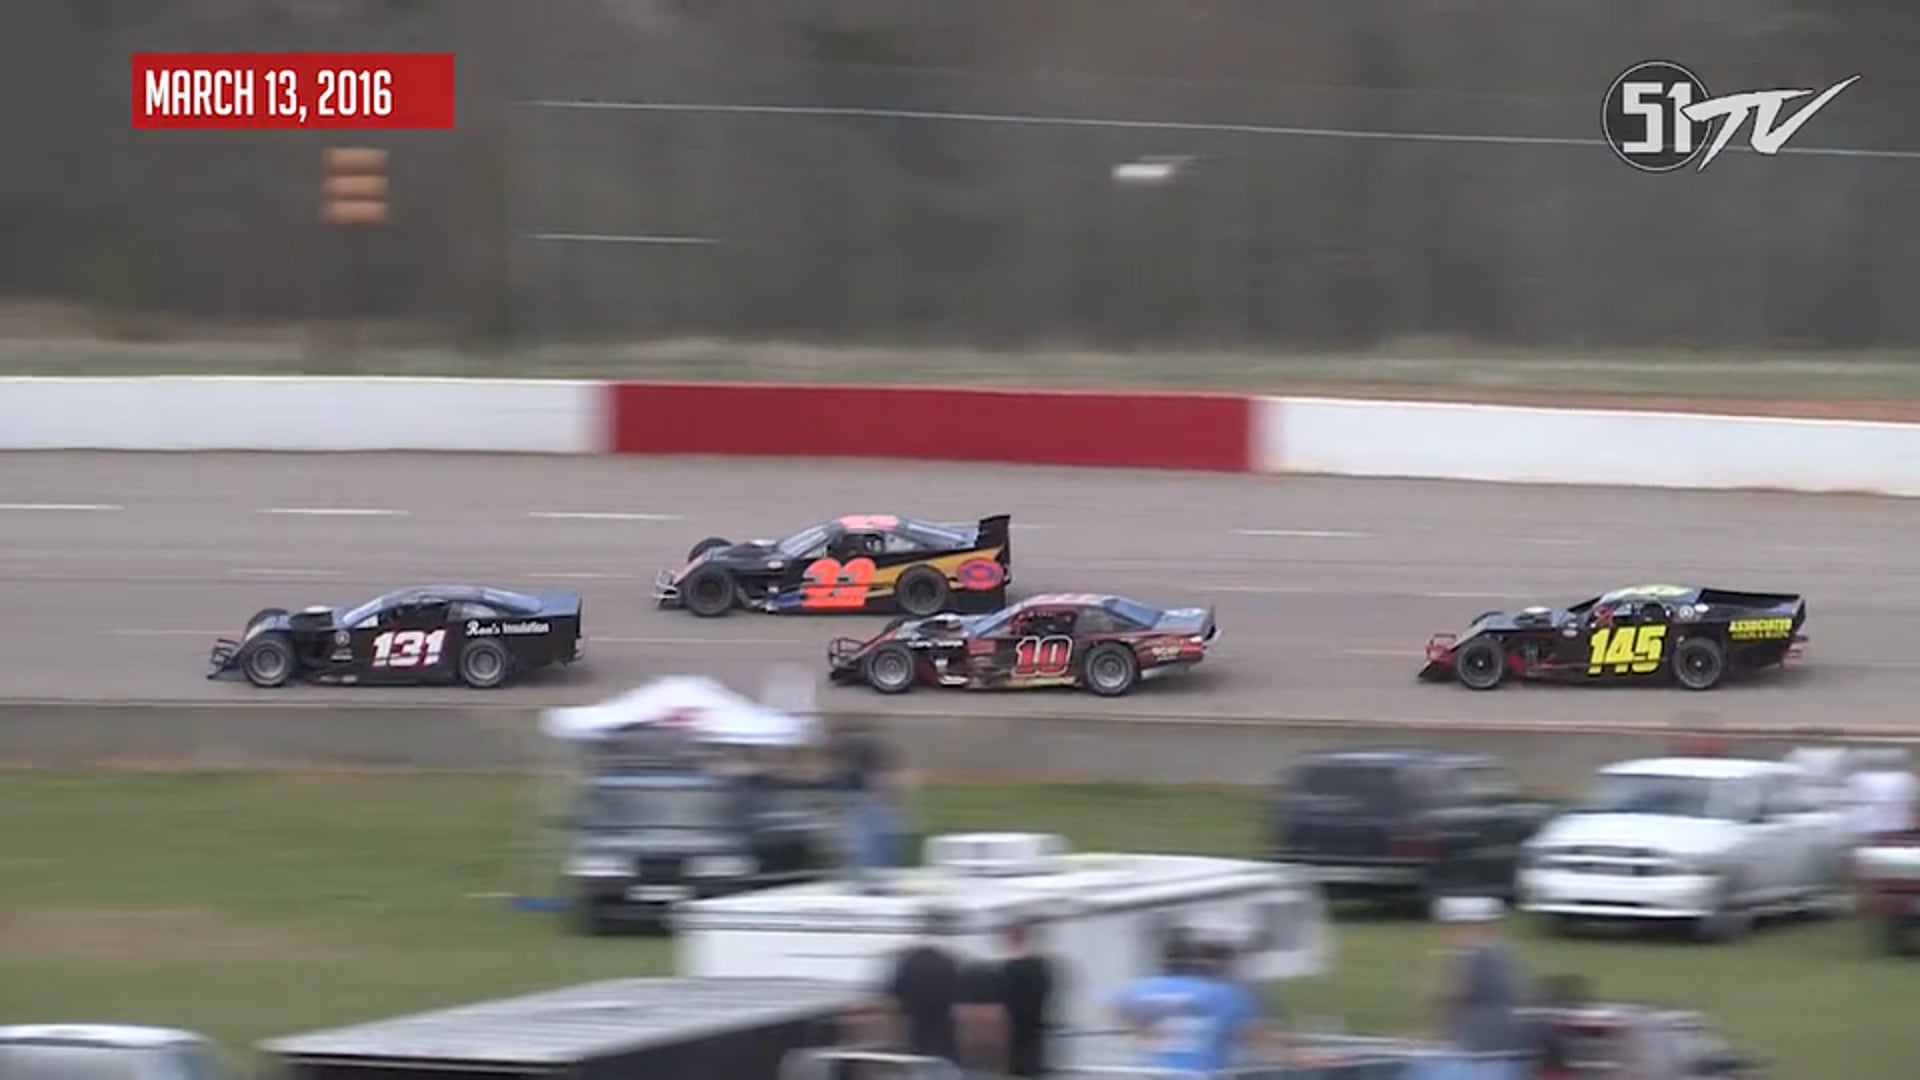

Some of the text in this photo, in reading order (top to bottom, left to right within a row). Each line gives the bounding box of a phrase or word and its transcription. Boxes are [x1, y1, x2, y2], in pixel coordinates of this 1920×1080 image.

[801, 557, 877, 607] 22
[372, 630, 446, 667] 131
[465, 620, 549, 635] Ron's Insulation
[1011, 634, 1072, 677] 10
[1588, 625, 1667, 675] 145
